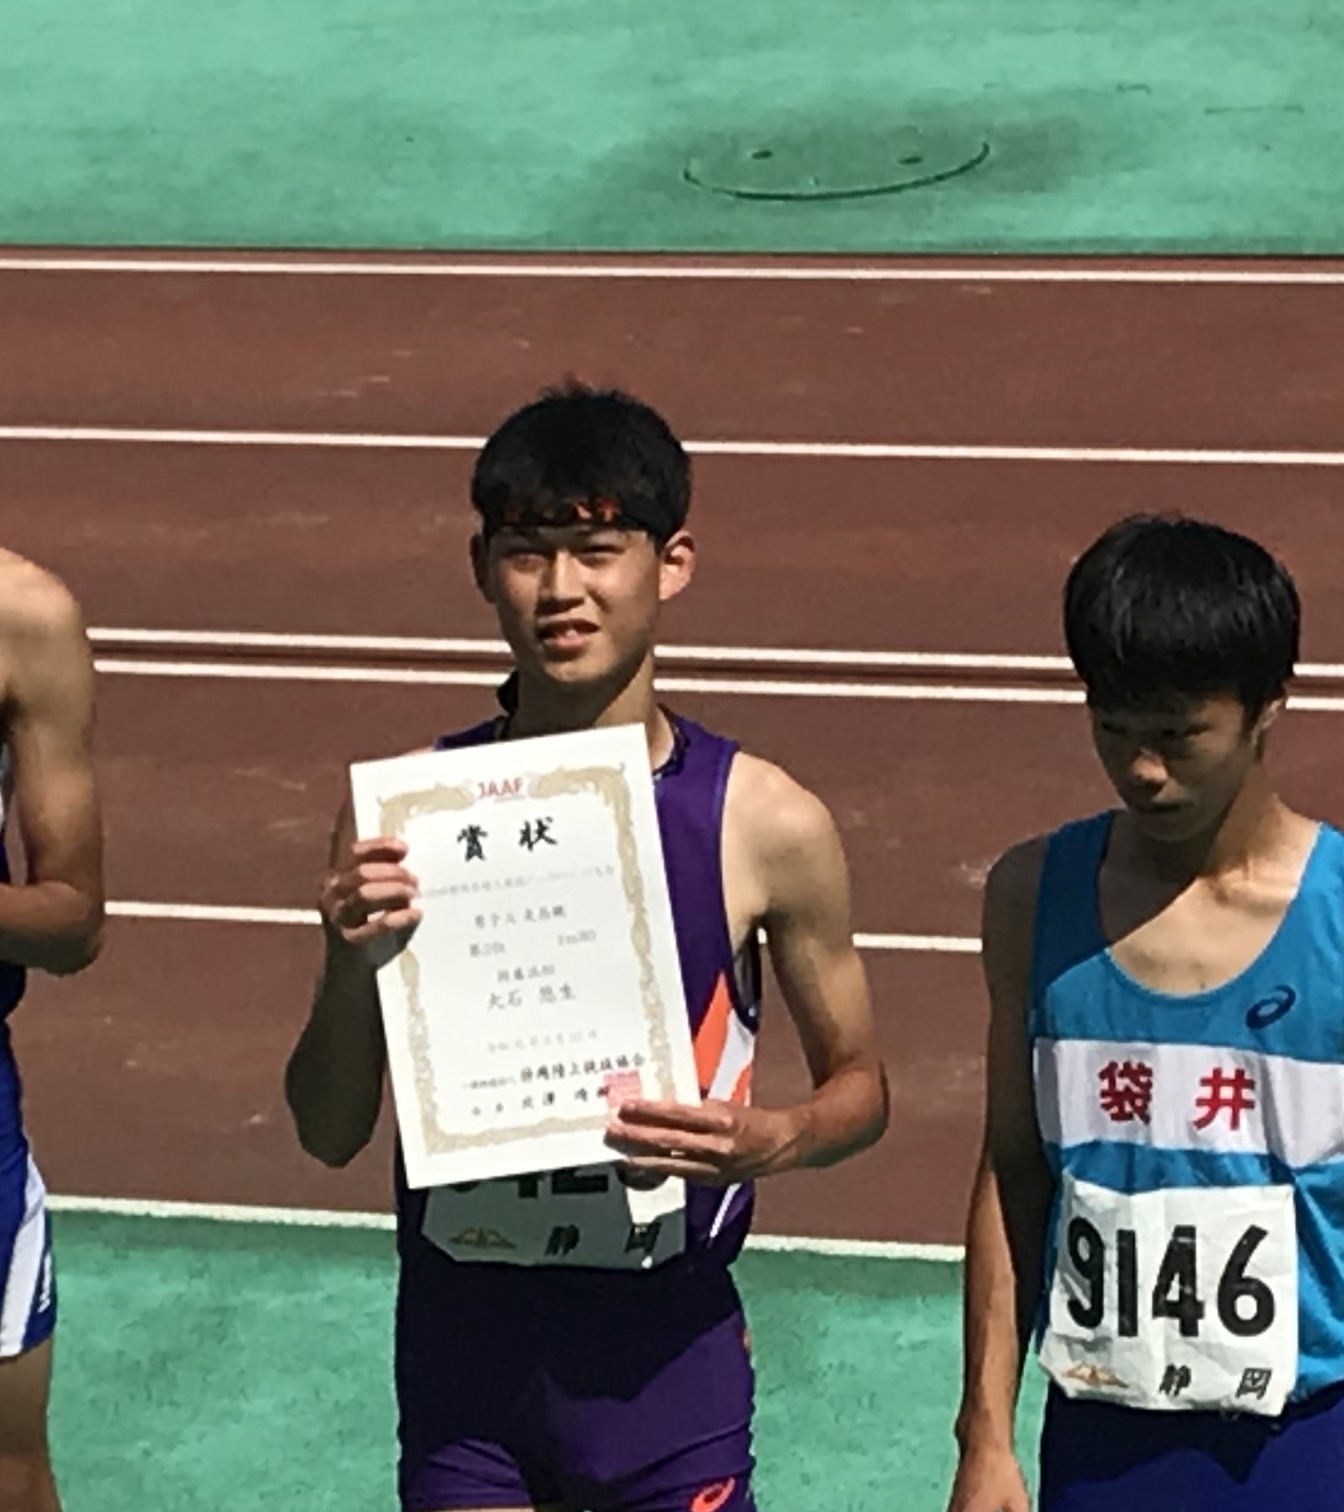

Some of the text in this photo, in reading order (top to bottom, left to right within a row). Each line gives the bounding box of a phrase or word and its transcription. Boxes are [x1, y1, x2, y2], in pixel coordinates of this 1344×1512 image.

[457, 816, 558, 862] 賞状
[1099, 1060, 1256, 1131] 袋井
[1067, 1216, 1276, 1338] 9146
[1159, 1363, 1272, 1399] 静岡
